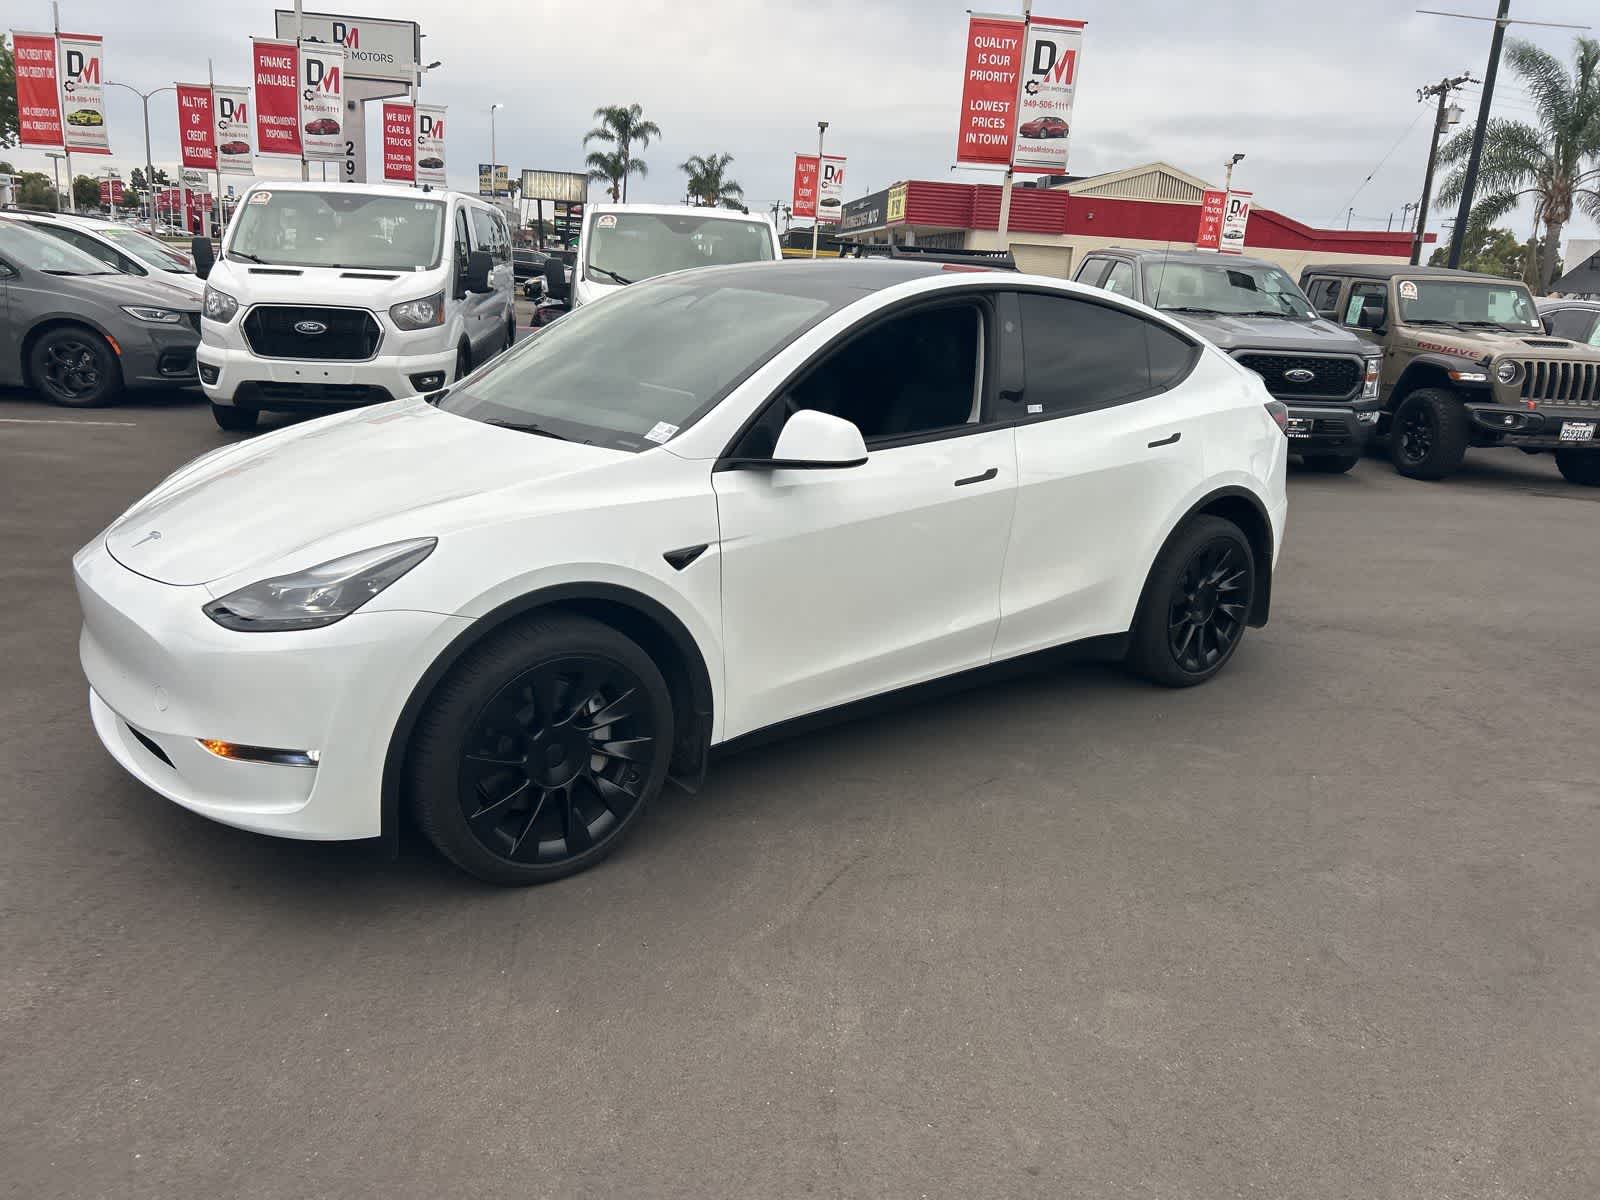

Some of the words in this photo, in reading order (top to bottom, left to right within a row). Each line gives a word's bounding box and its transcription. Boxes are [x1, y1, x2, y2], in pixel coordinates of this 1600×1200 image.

[333, 22, 359, 49] DM
[974, 36, 1018, 50] QUALITY
[259, 55, 292, 69] FINANCE
[351, 51, 394, 63] MOTORS
[978, 53, 988, 64] IS
[989, 54, 1010, 66] OUR
[1032, 39, 1077, 85] DM
[66, 50, 100, 85] DM
[257, 73, 296, 88] AVAILABLE
[306, 58, 340, 94] DM
[969, 70, 1016, 84] PRIORITY
[182, 95, 193, 107] ALL
[193, 97, 208, 109] TYPE
[970, 99, 1010, 113] LOWEST
[220, 97, 248, 124] DM
[191, 113, 201, 125] OF
[386, 113, 397, 121] WE
[398, 114, 412, 123] BUY
[971, 117, 1006, 129] PRICES
[387, 125, 405, 134] CARS
[405, 126, 412, 135] &
[420, 115, 445, 140] DM
[186, 129, 207, 142] CREDIT
[386, 137, 412, 147] TRUCKS
[965, 133, 976, 144] IN
[977, 133, 1008, 145] TOWN
[184, 146, 213, 159] WELCOME
[386, 162, 413, 172] ACCEPTED
[824, 165, 843, 184] DM
[1208, 197, 1222, 205] CARS
[1204, 206, 1222, 214] TRUCKS
[1231, 199, 1249, 218] DM
[1417, 341, 1480, 358] MOJAVE
